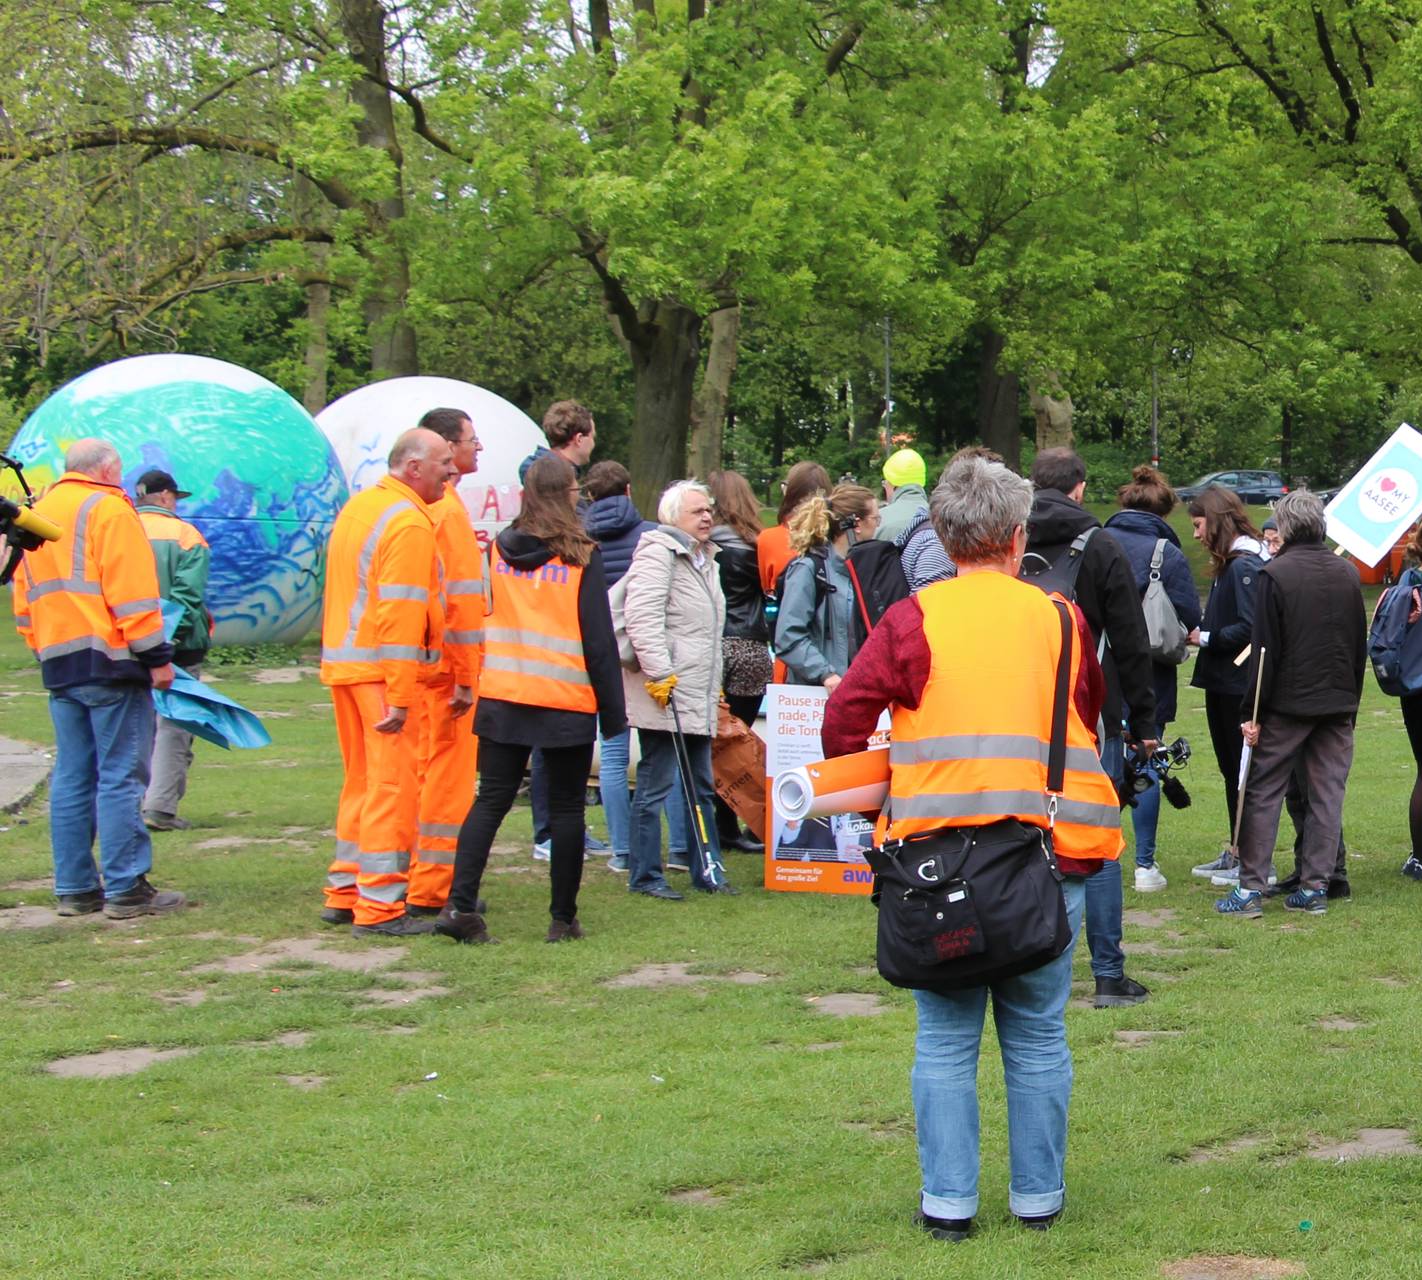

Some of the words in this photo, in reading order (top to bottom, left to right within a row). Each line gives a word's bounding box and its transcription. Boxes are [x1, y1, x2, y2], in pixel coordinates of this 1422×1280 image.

[1363, 489, 1401, 516] AASEE
[1391, 489, 1411, 503] MY
[778, 694, 812, 706] Pause
[778, 709, 809, 722] nade,
[778, 723, 796, 735] die
[797, 724, 822, 736] Ton
